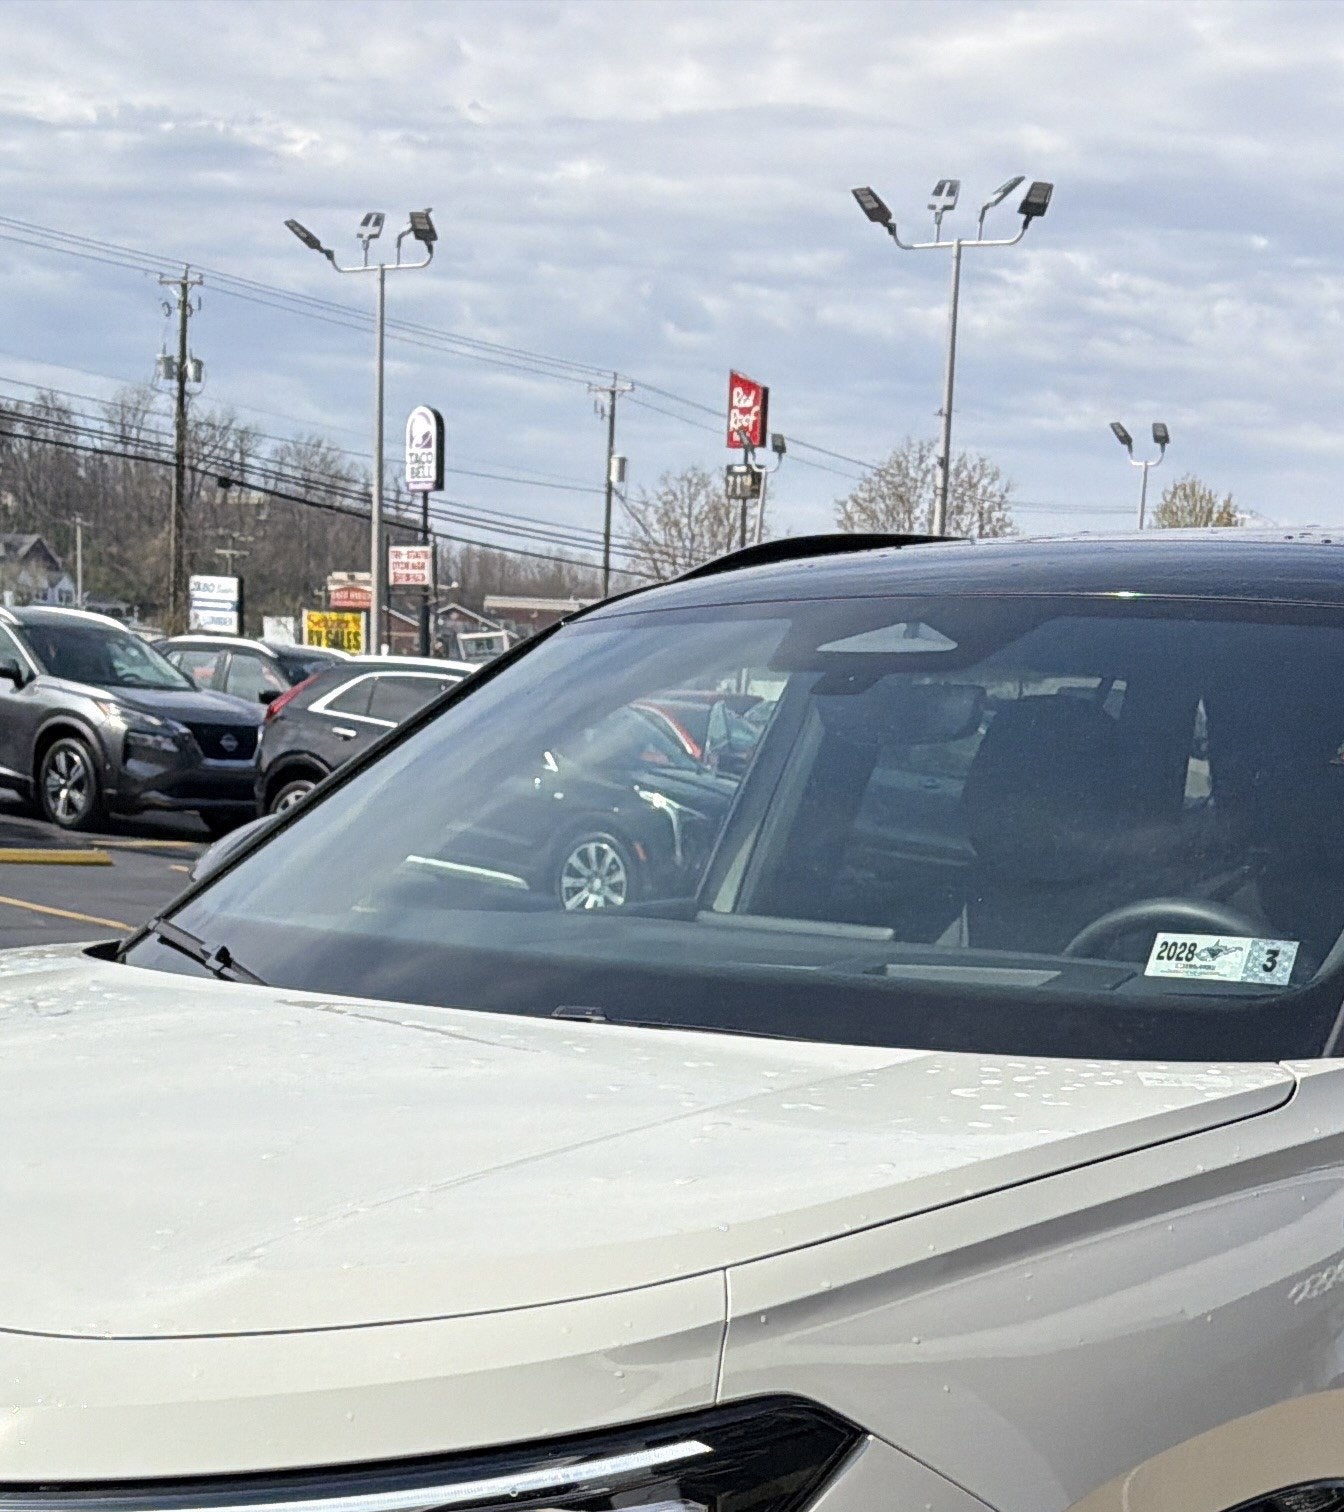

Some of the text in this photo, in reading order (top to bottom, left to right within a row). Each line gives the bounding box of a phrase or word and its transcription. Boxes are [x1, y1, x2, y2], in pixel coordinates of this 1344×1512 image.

[408, 452, 433, 465] TACO
[409, 466, 432, 479] BELL
[1157, 941, 1280, 973] 2028 3
